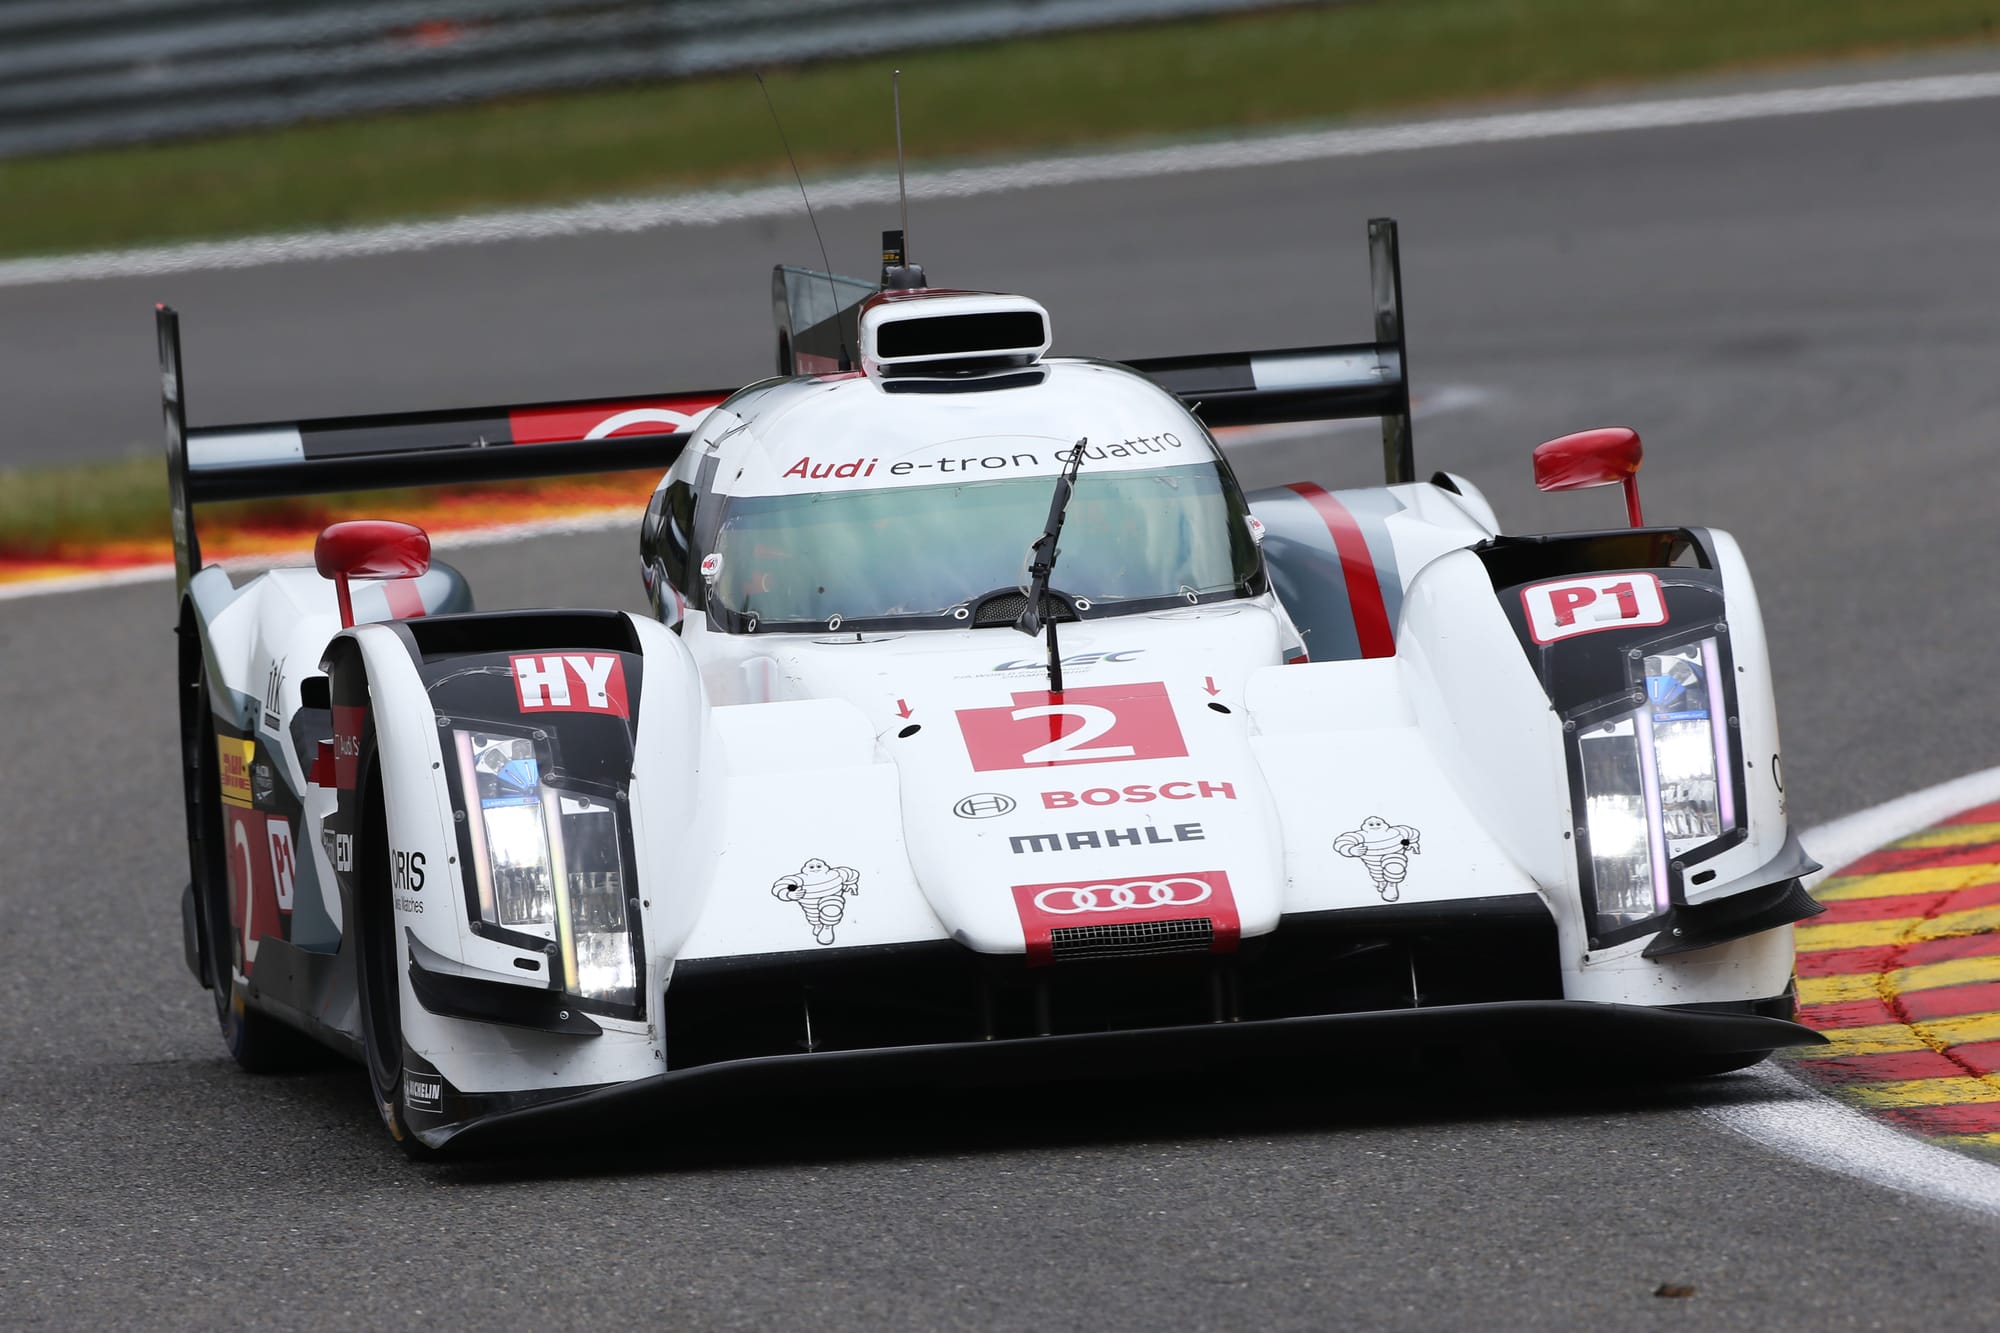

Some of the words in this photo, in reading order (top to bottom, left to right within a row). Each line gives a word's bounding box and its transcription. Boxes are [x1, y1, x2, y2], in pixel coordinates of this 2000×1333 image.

[782, 457, 878, 479] Audi
[890, 453, 1039, 476] e-tron
[1054, 432, 1182, 466] quattro
[1548, 582, 1640, 627] P1
[514, 655, 616, 709] HY
[1011, 703, 1136, 764] 2
[1040, 781, 1237, 810] BOSCH
[1008, 822, 1205, 854] MAHLE
[392, 848, 426, 892] ORIS
